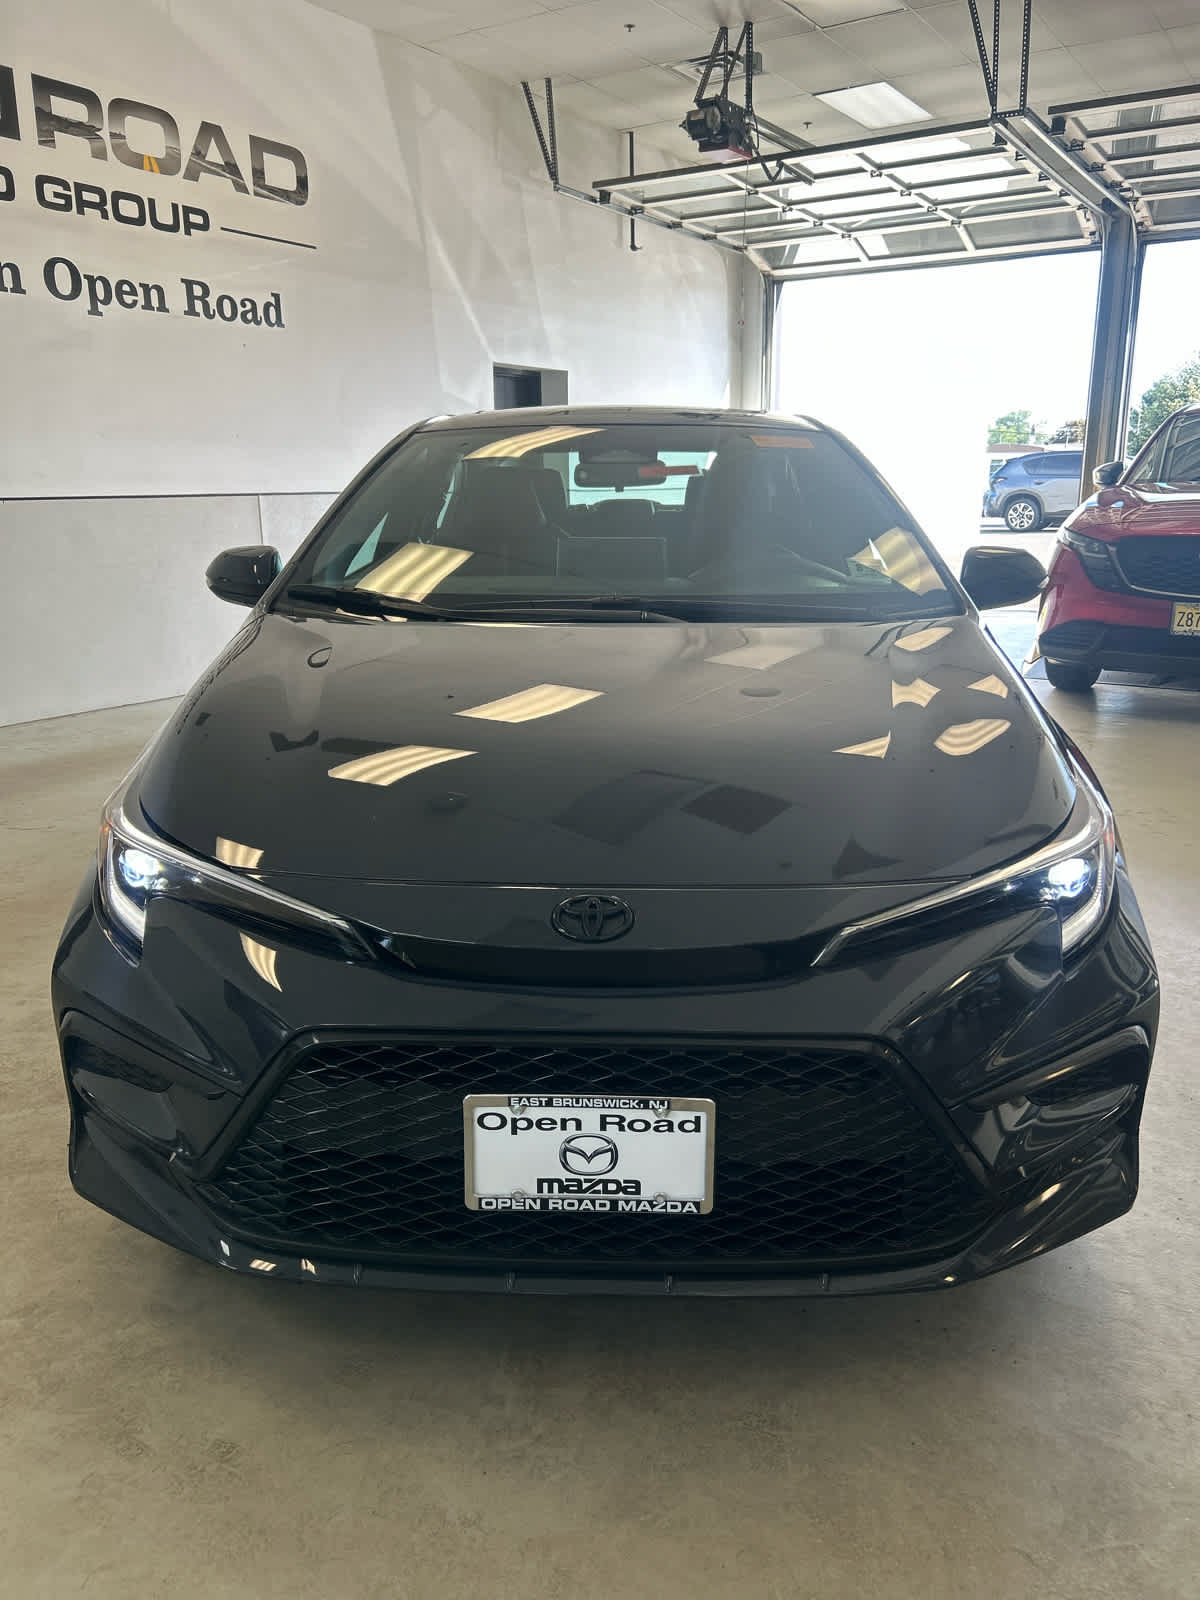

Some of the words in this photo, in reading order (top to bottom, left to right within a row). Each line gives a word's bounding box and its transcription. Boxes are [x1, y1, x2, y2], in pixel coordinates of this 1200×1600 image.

[35, 174, 210, 236] GROUP
[43, 256, 170, 317] Open
[180, 277, 286, 329] Road
[510, 1097, 548, 1107] EAST
[552, 1098, 644, 1109] BRUNSWICK,
[649, 1100, 668, 1109] NJ
[477, 1112, 582, 1136] Open
[599, 1114, 701, 1133] Road
[536, 1177, 642, 1196] mazda
[481, 1198, 541, 1211] OPEN
[548, 1199, 610, 1212] ROAD
[618, 1200, 698, 1214] MAZDA
